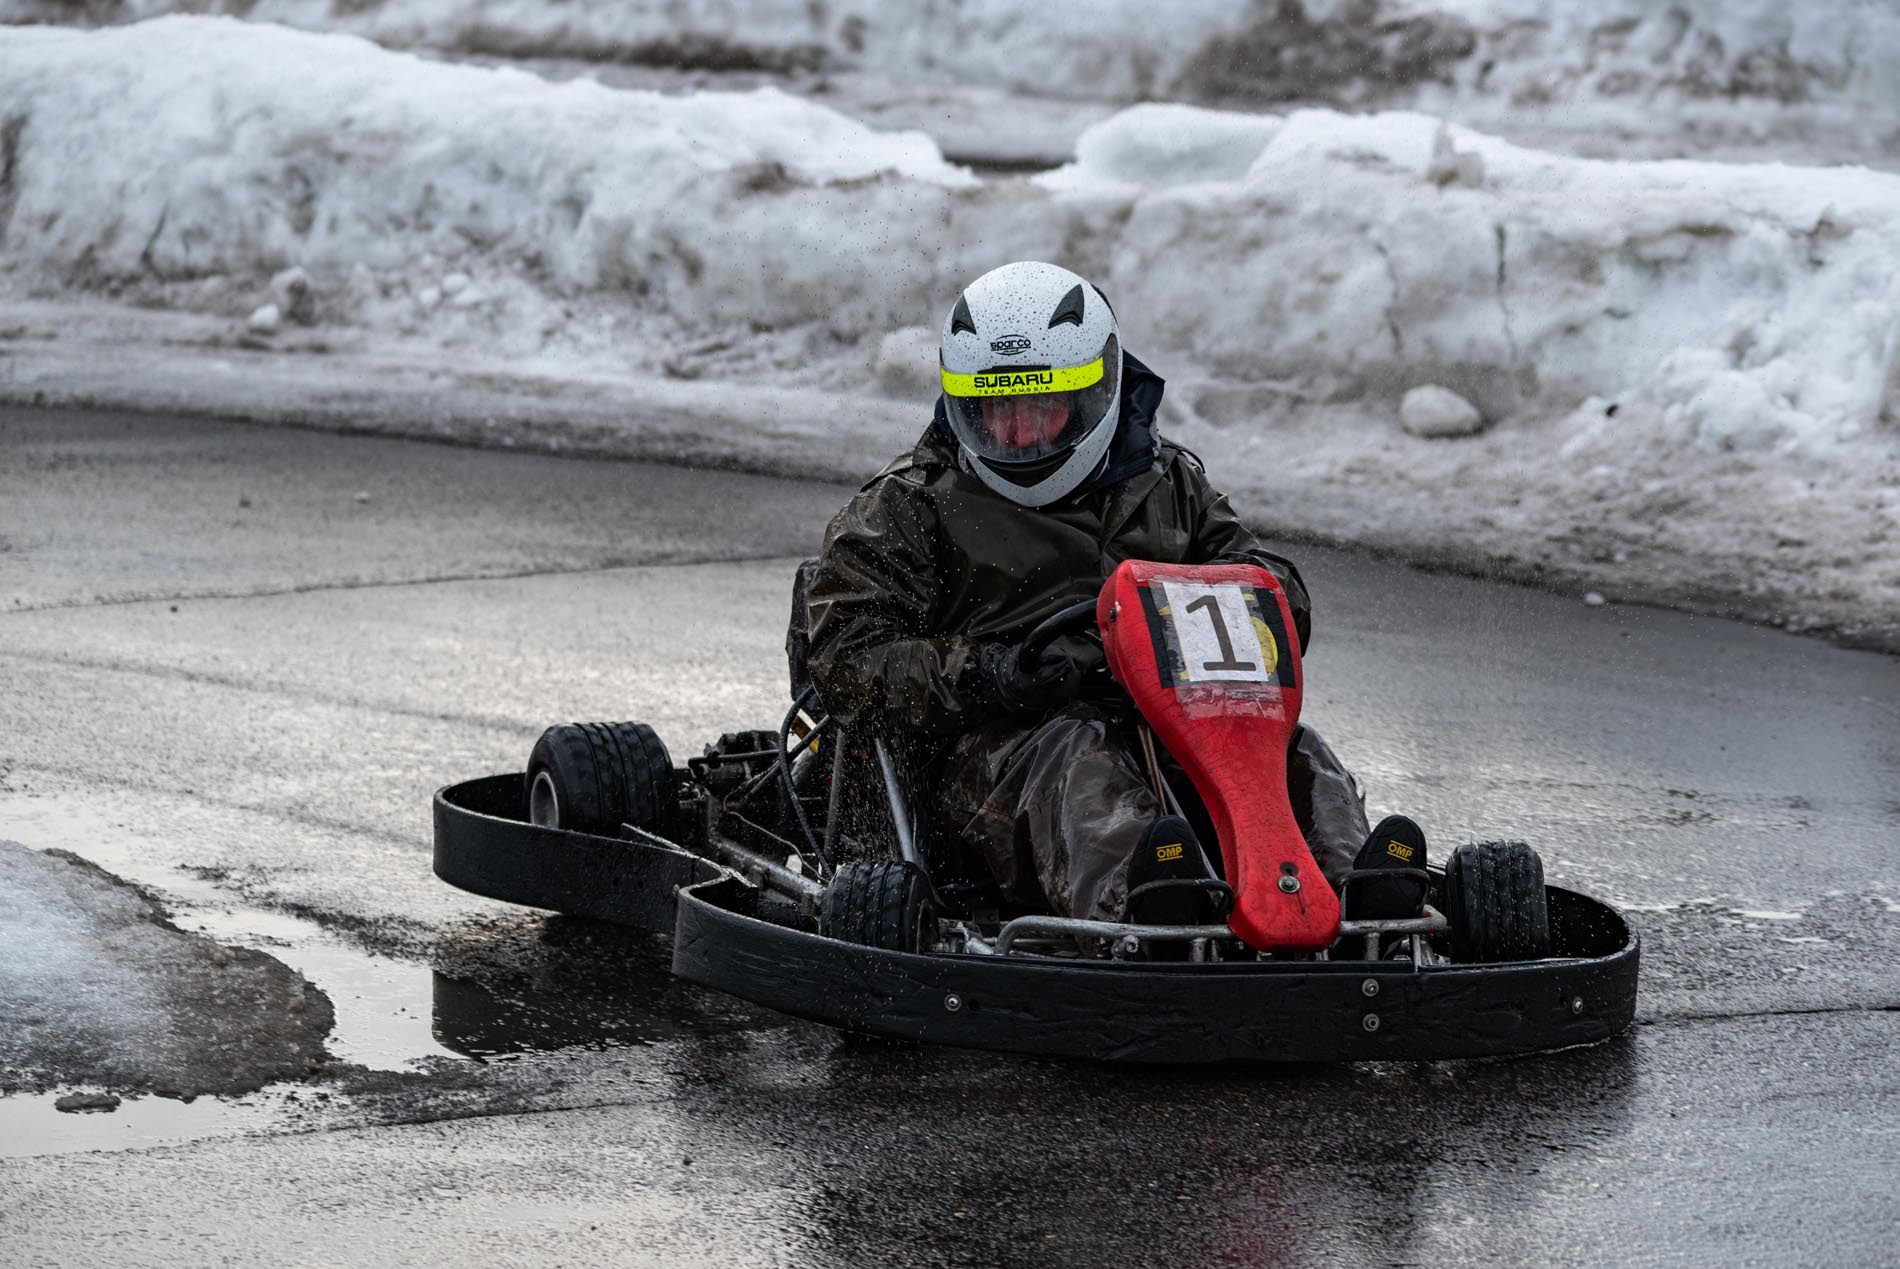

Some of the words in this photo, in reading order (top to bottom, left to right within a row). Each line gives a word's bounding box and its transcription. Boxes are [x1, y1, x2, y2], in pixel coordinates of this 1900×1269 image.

[990, 339, 1031, 350] sparco
[974, 372, 1053, 388] SUBARU
[1185, 595, 1257, 671] 1
[1156, 846, 1182, 859] OMP
[1388, 843, 1413, 858] OMP
